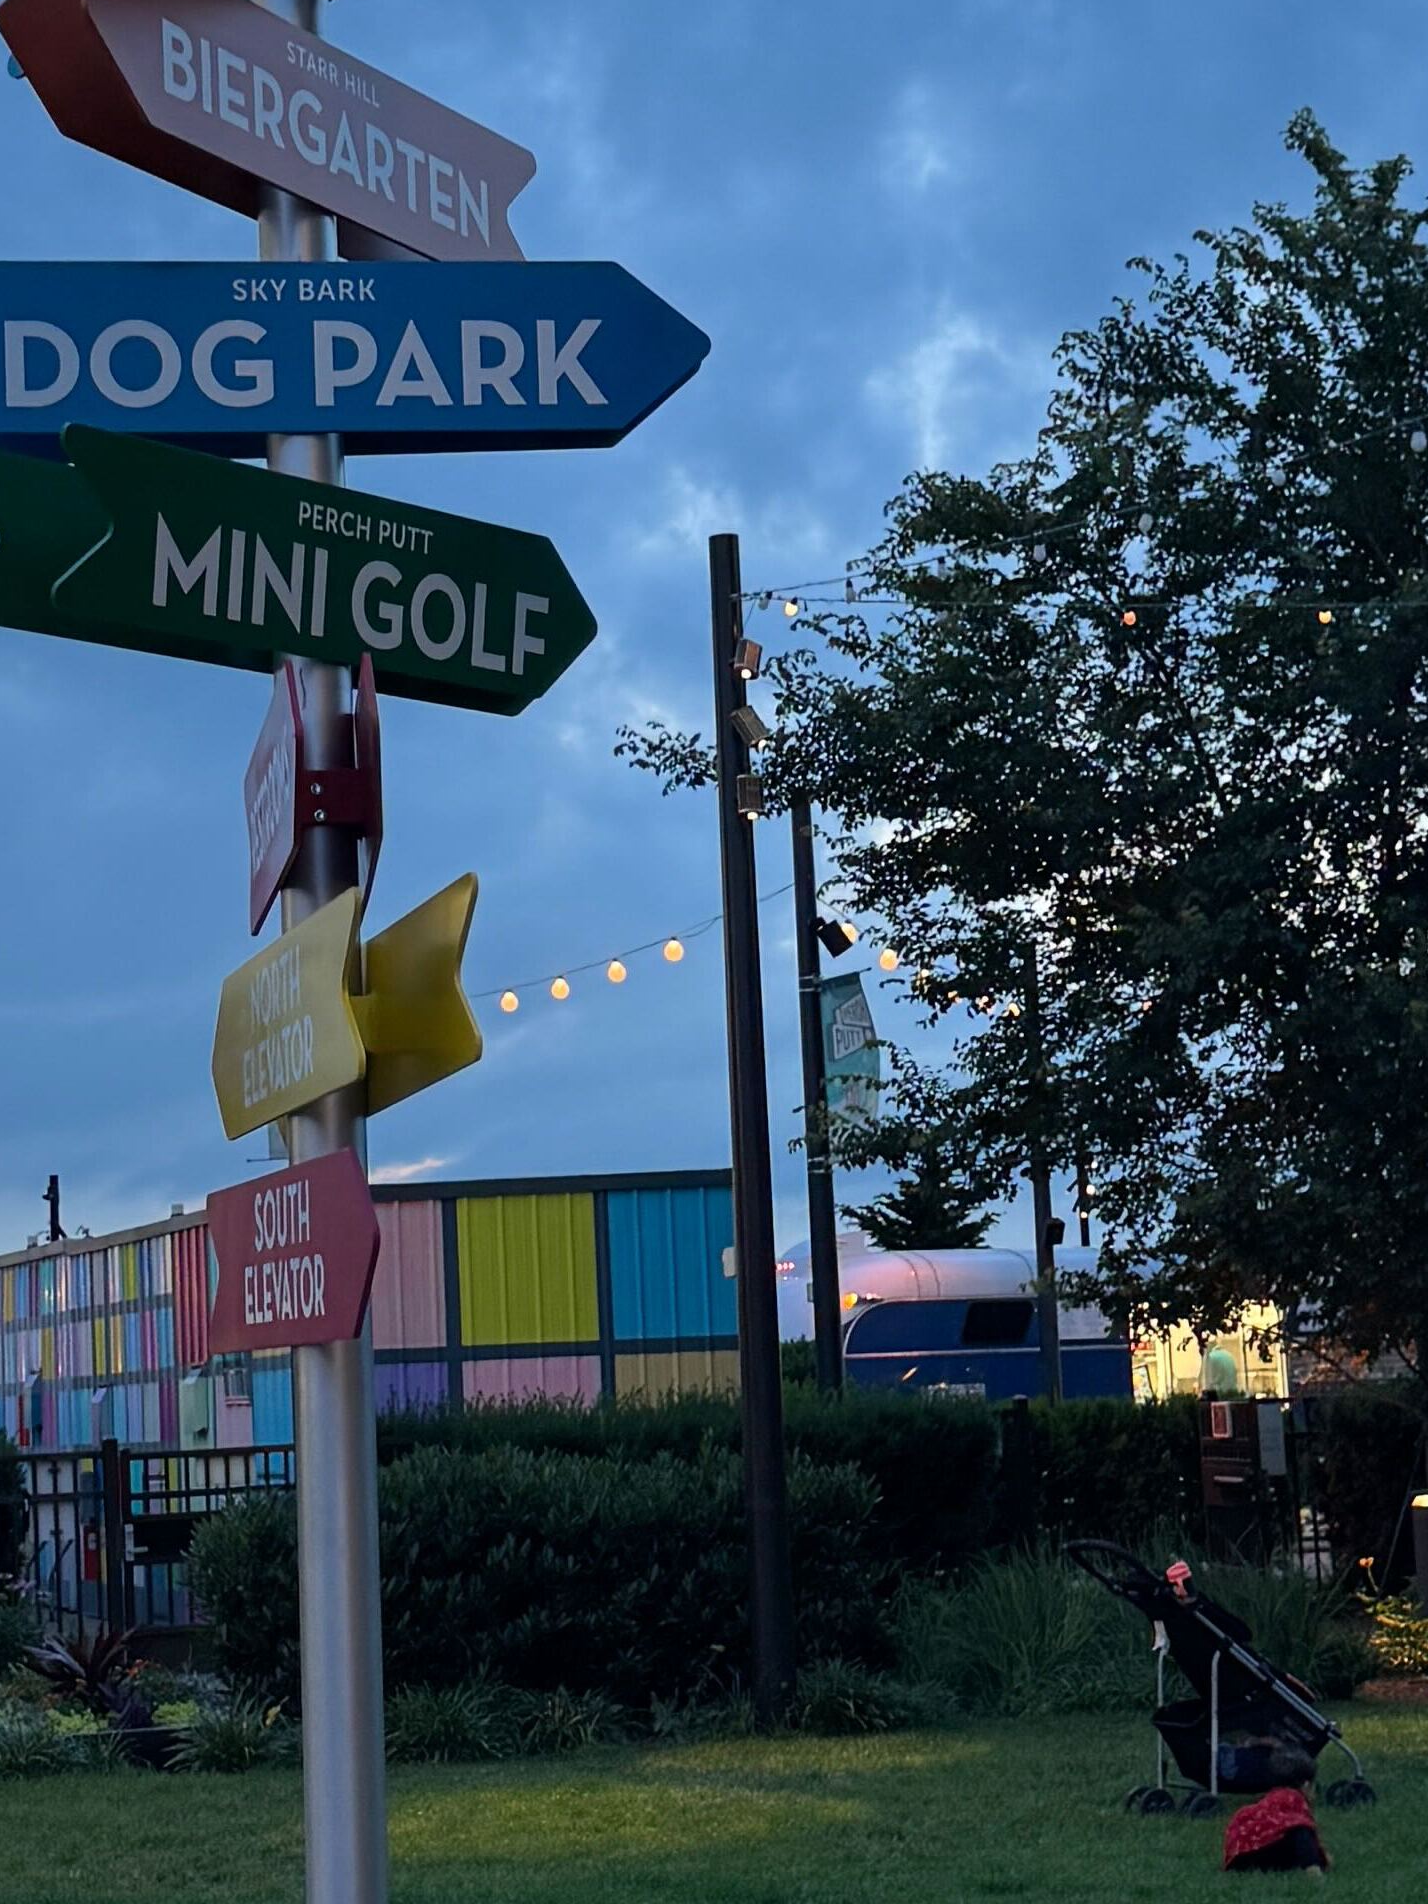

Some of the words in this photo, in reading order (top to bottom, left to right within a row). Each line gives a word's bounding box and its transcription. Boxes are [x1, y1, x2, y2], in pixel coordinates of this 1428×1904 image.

[286, 41, 340, 87] STARR
[344, 71, 380, 109] HILL
[161, 17, 491, 248] BIERGARTEN
[232, 279, 286, 302] SKY
[298, 279, 376, 302] BARK
[4, 319, 274, 408] DOG
[313, 319, 609, 406] PARK
[298, 500, 371, 543] PERCH
[378, 519, 434, 555] PUTT
[152, 511, 329, 637] MINI
[351, 560, 550, 676] GOLF
[250, 943, 301, 1031] NORTH
[243, 1014, 314, 1109] ELEVATOR
[254, 1179, 310, 1252] SOUTH
[244, 1253, 326, 1325] ELEVATOR
